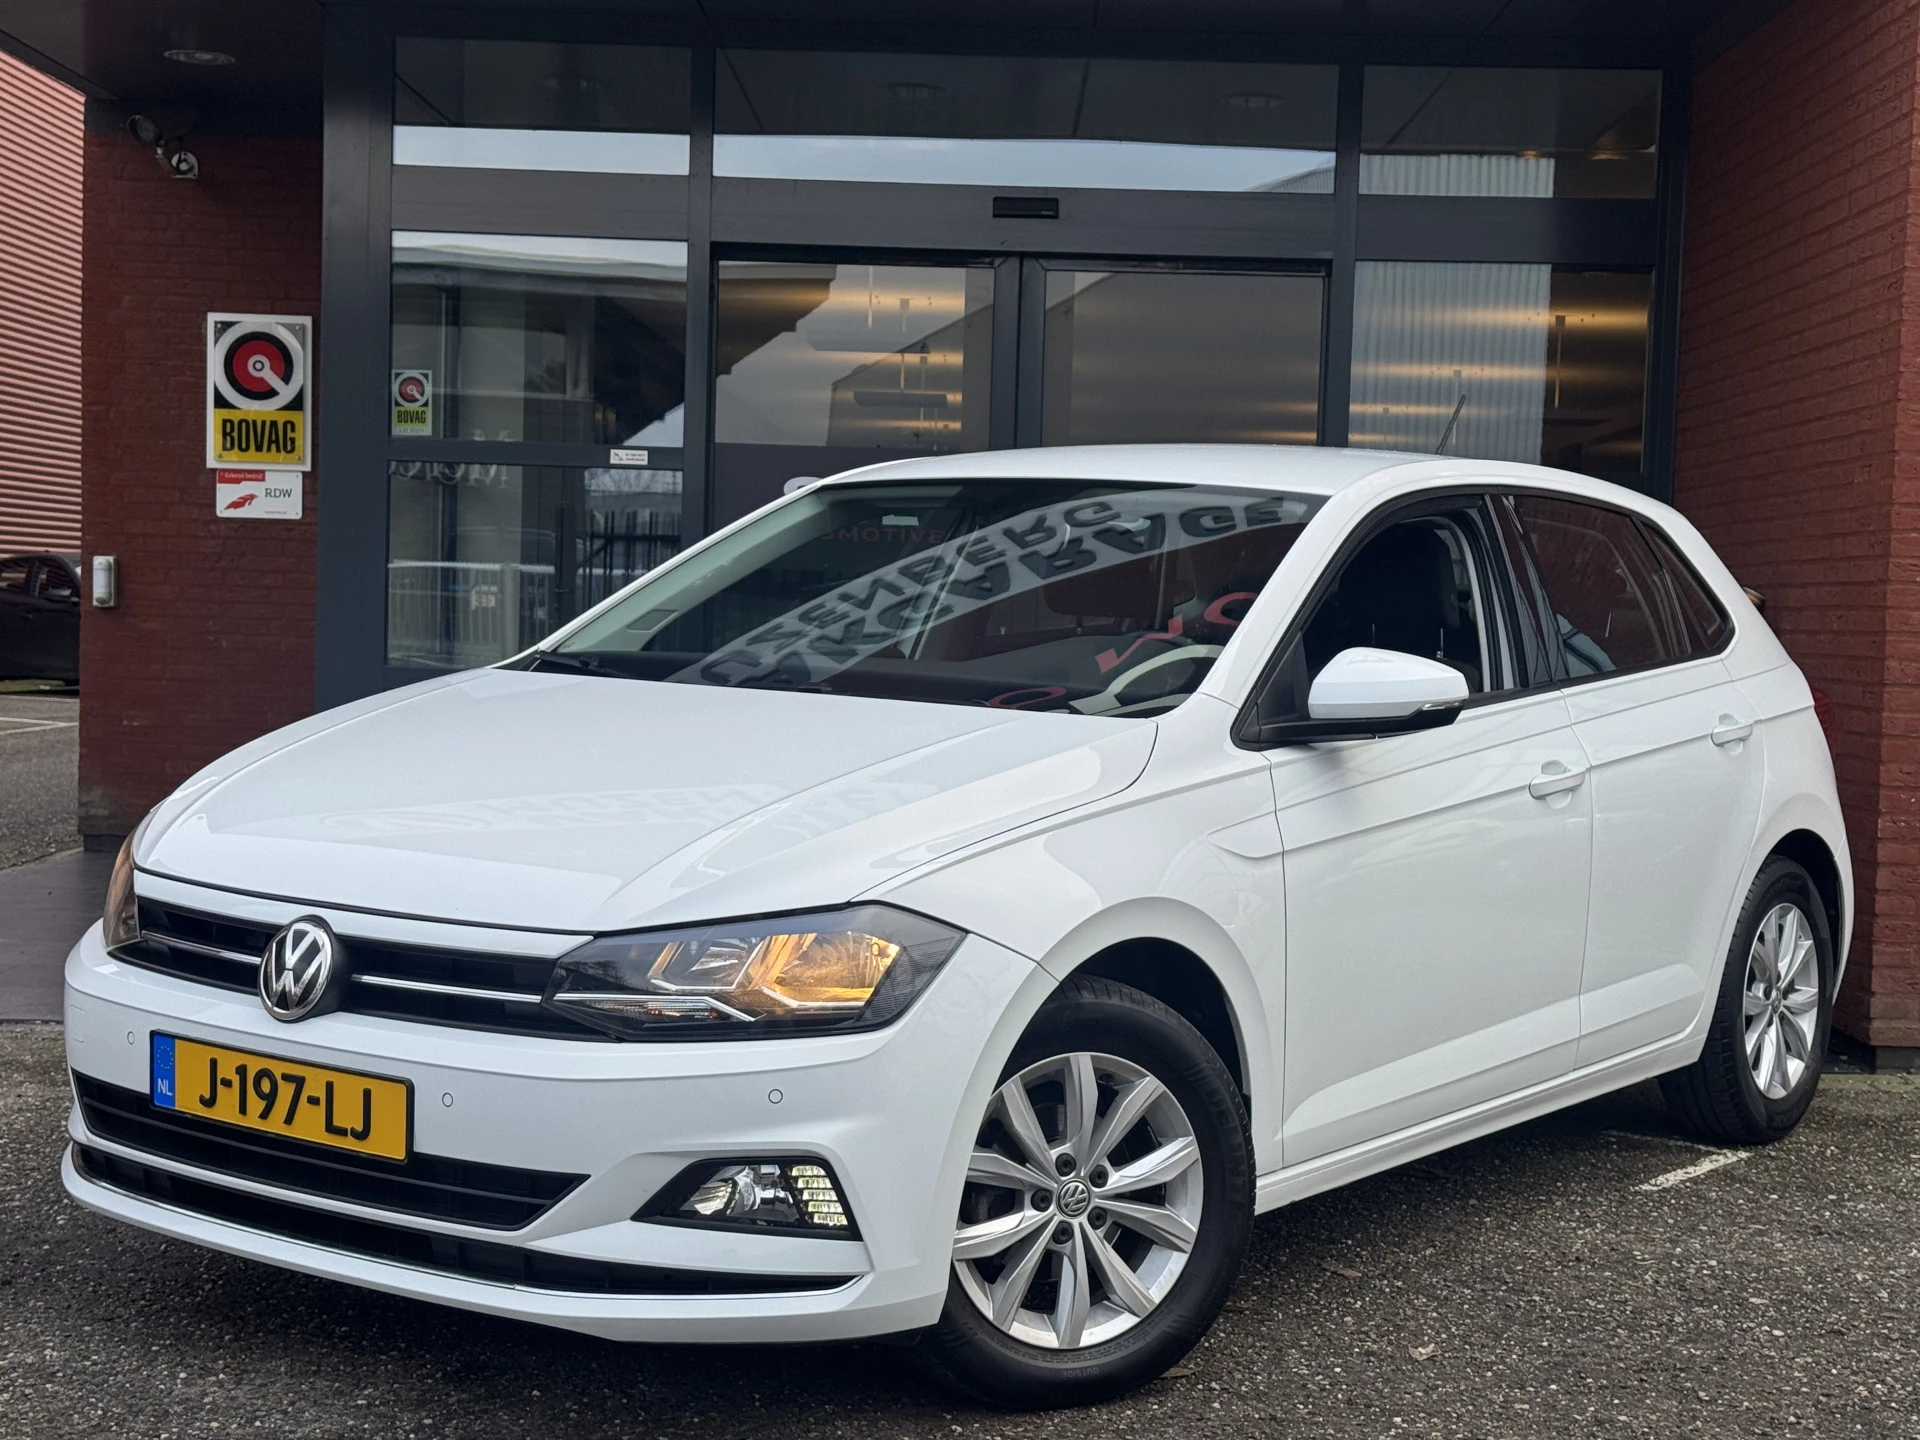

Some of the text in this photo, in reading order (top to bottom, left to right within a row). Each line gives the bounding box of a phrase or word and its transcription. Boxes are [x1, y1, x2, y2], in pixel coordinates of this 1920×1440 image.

[398, 409, 427, 424] BOVAG
[222, 418, 296, 454] BOVAG
[264, 487, 293, 499] RDW
[157, 1078, 173, 1096] NL
[199, 1057, 372, 1141] J-197-LJ
